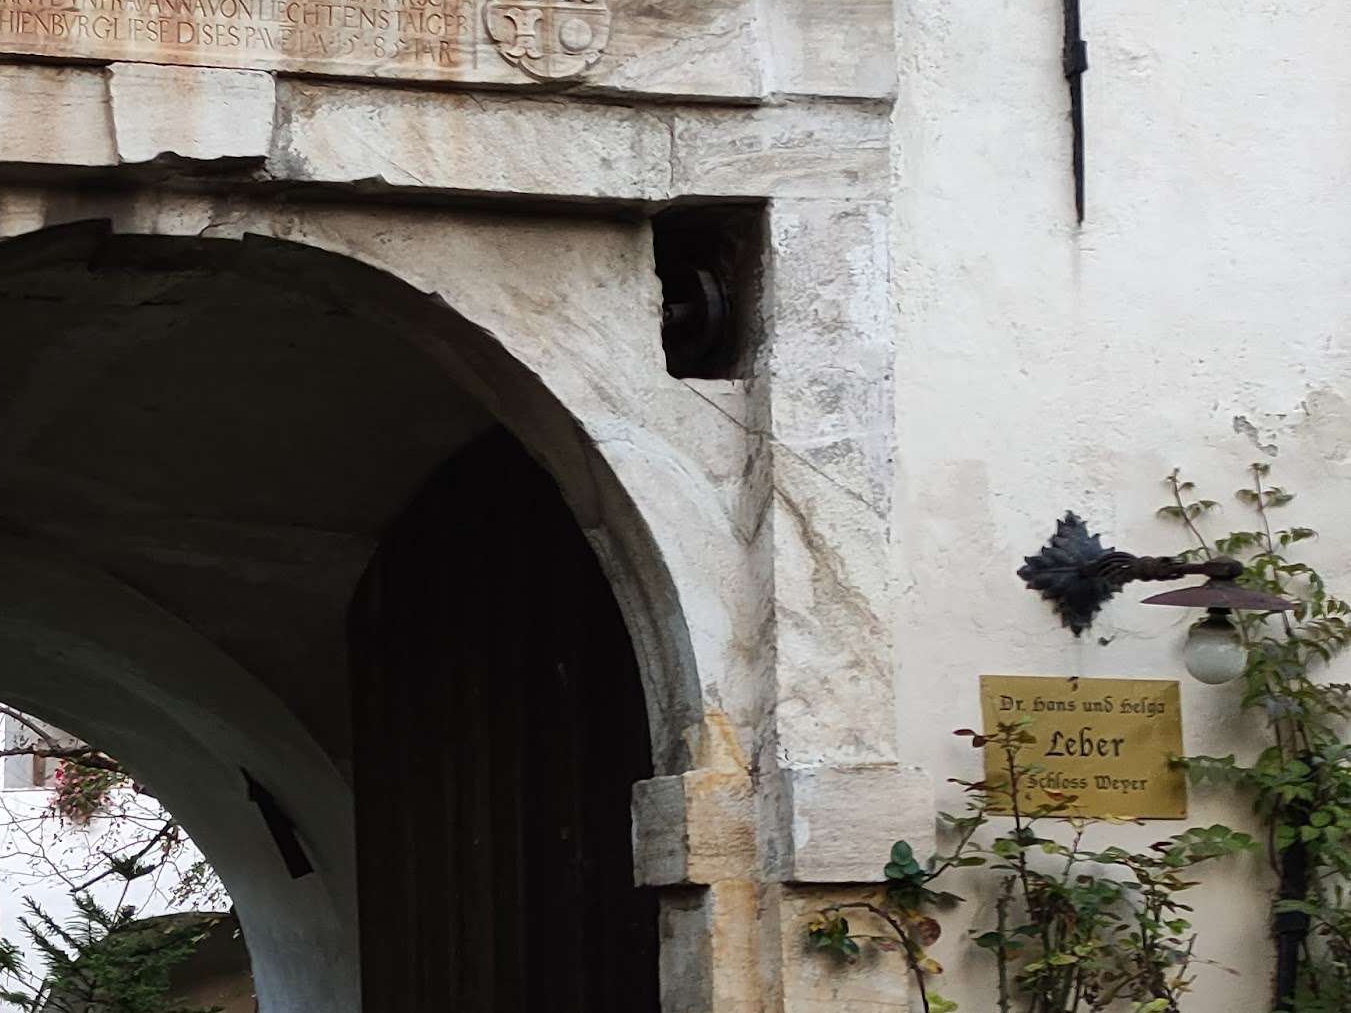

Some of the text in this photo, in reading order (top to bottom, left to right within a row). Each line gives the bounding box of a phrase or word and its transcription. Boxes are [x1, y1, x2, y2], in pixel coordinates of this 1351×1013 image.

[999, 695, 1165, 717] Dr. Hans und Helga
[1044, 727, 1125, 757] Leber
[1094, 775, 1148, 794] Weyer
